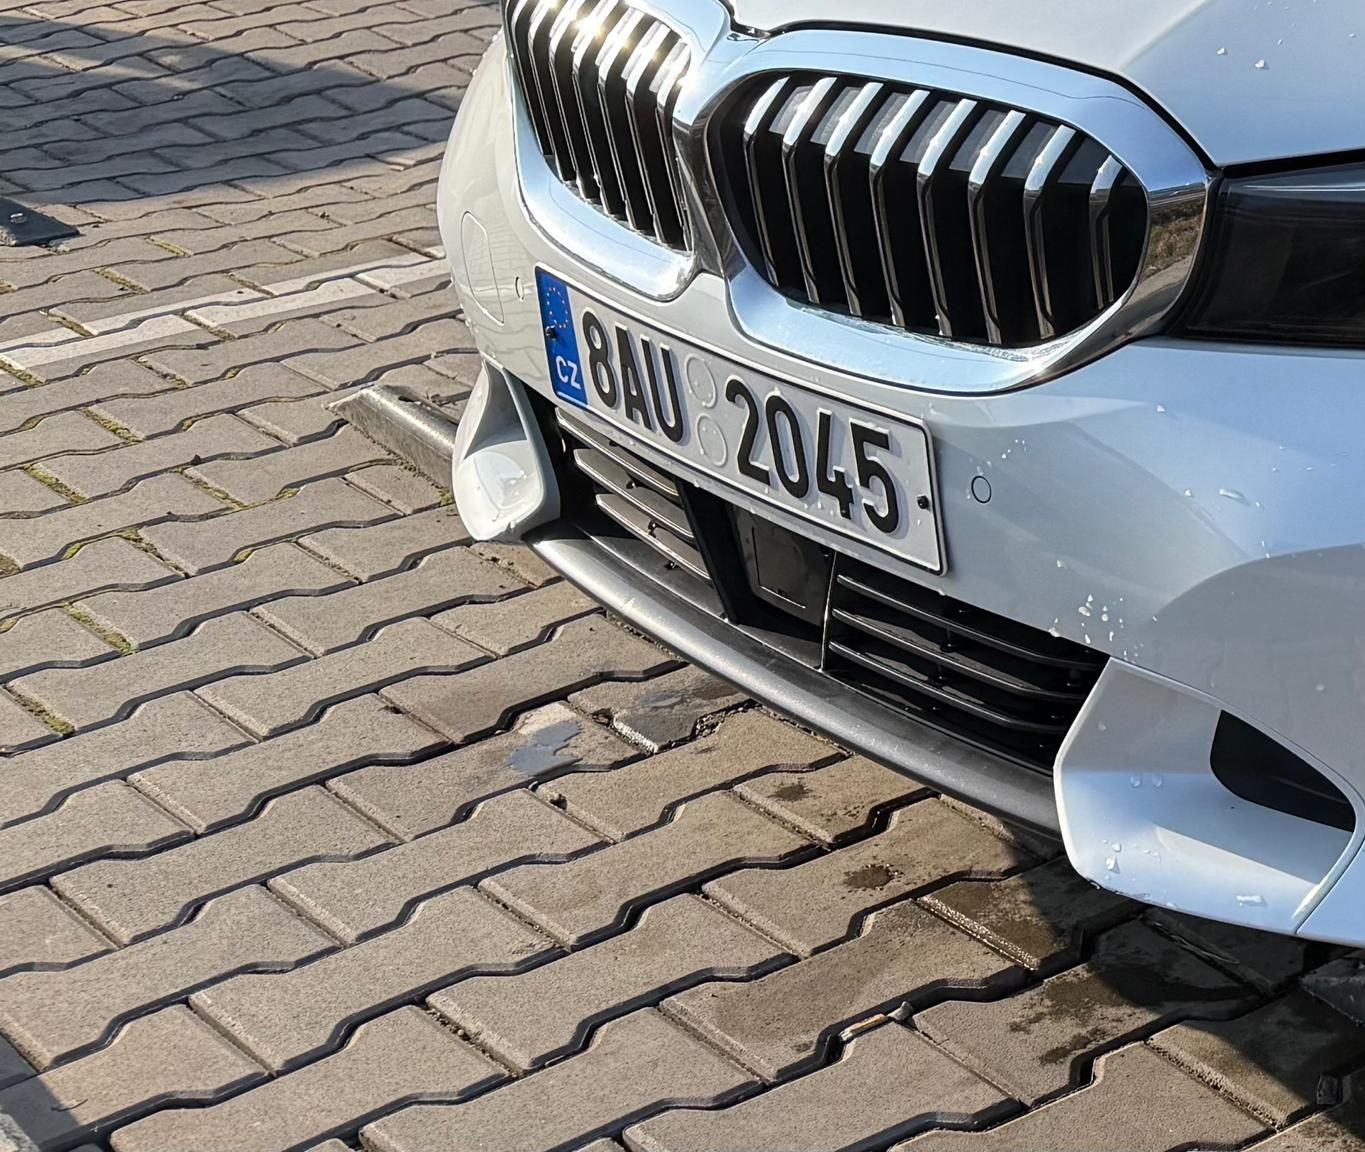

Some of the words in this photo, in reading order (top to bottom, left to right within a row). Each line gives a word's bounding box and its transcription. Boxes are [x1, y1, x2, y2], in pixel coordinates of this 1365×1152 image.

[555, 355, 582, 390] CZ
[582, 311, 684, 443] 8AU
[725, 374, 900, 534] 2045
